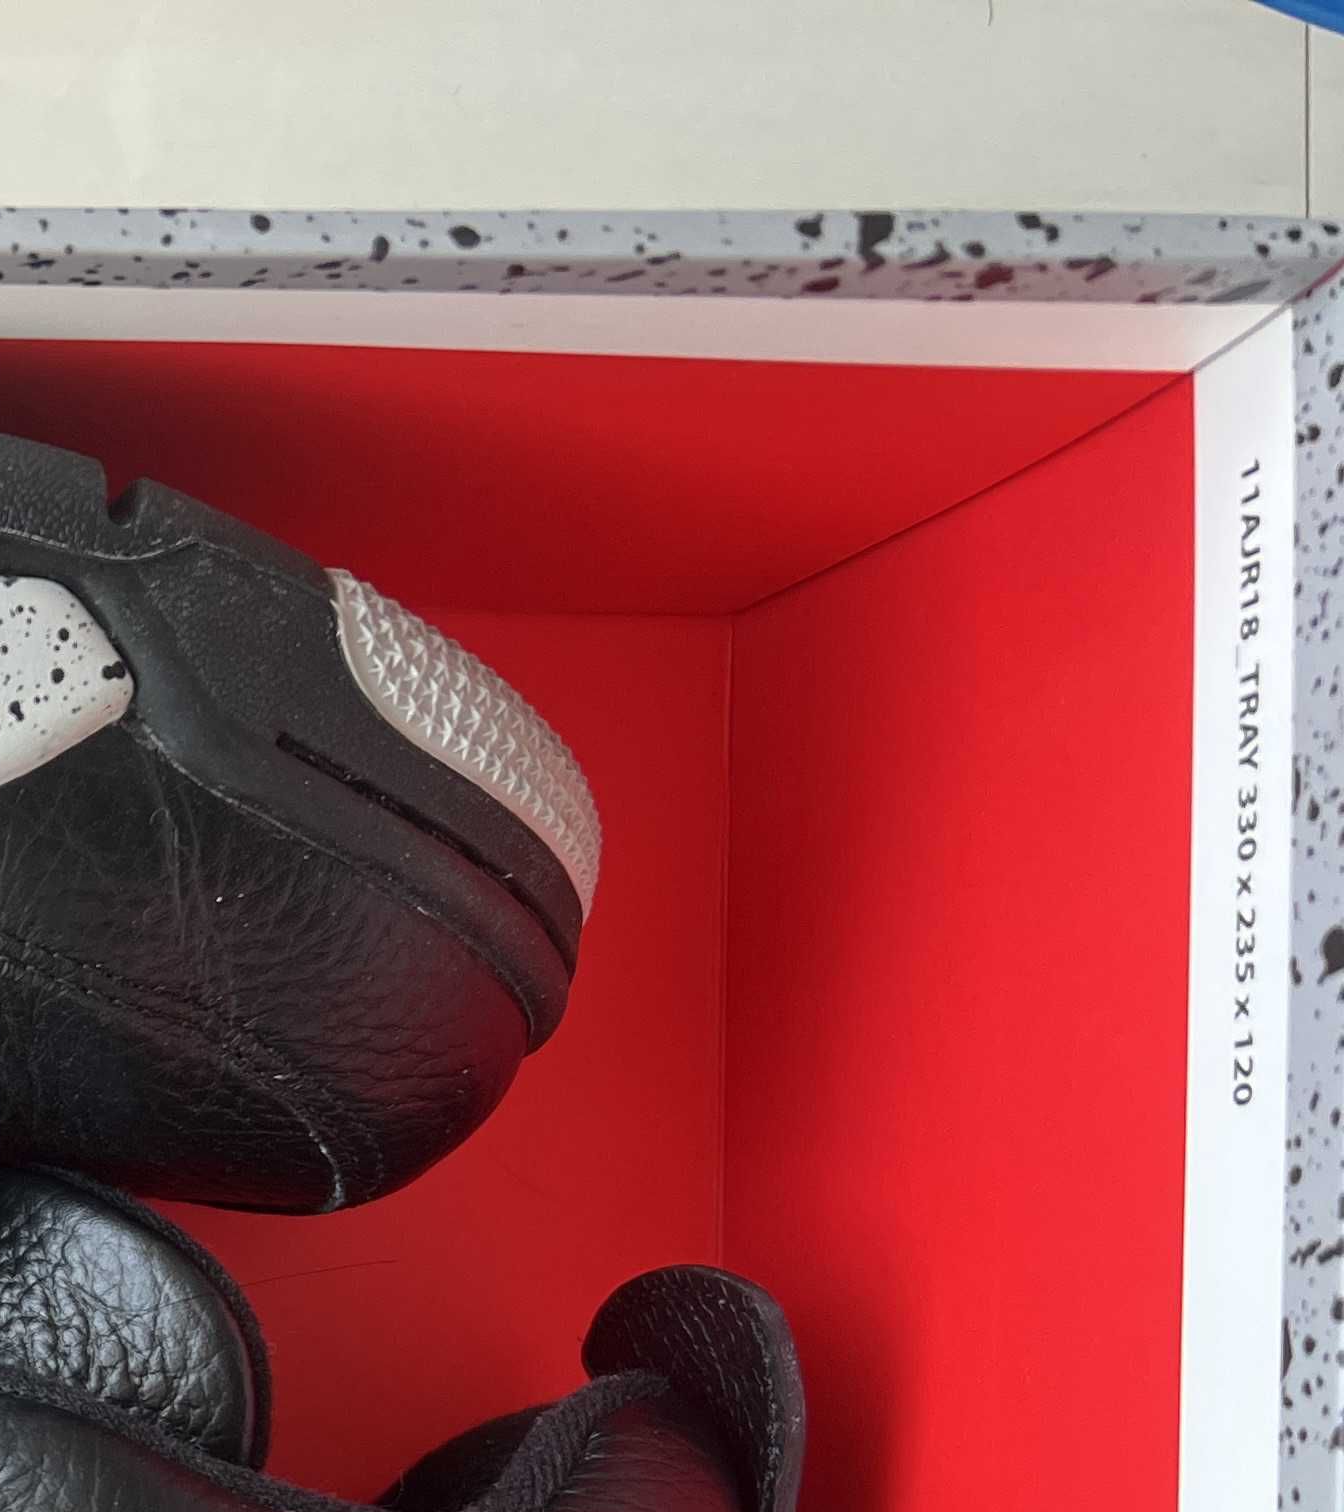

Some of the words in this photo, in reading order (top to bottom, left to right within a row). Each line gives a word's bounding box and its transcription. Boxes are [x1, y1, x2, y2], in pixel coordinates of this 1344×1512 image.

[1237, 785, 1258, 862] 330
[1234, 908, 1256, 983] 235
[1233, 1032, 1253, 1107] 120
